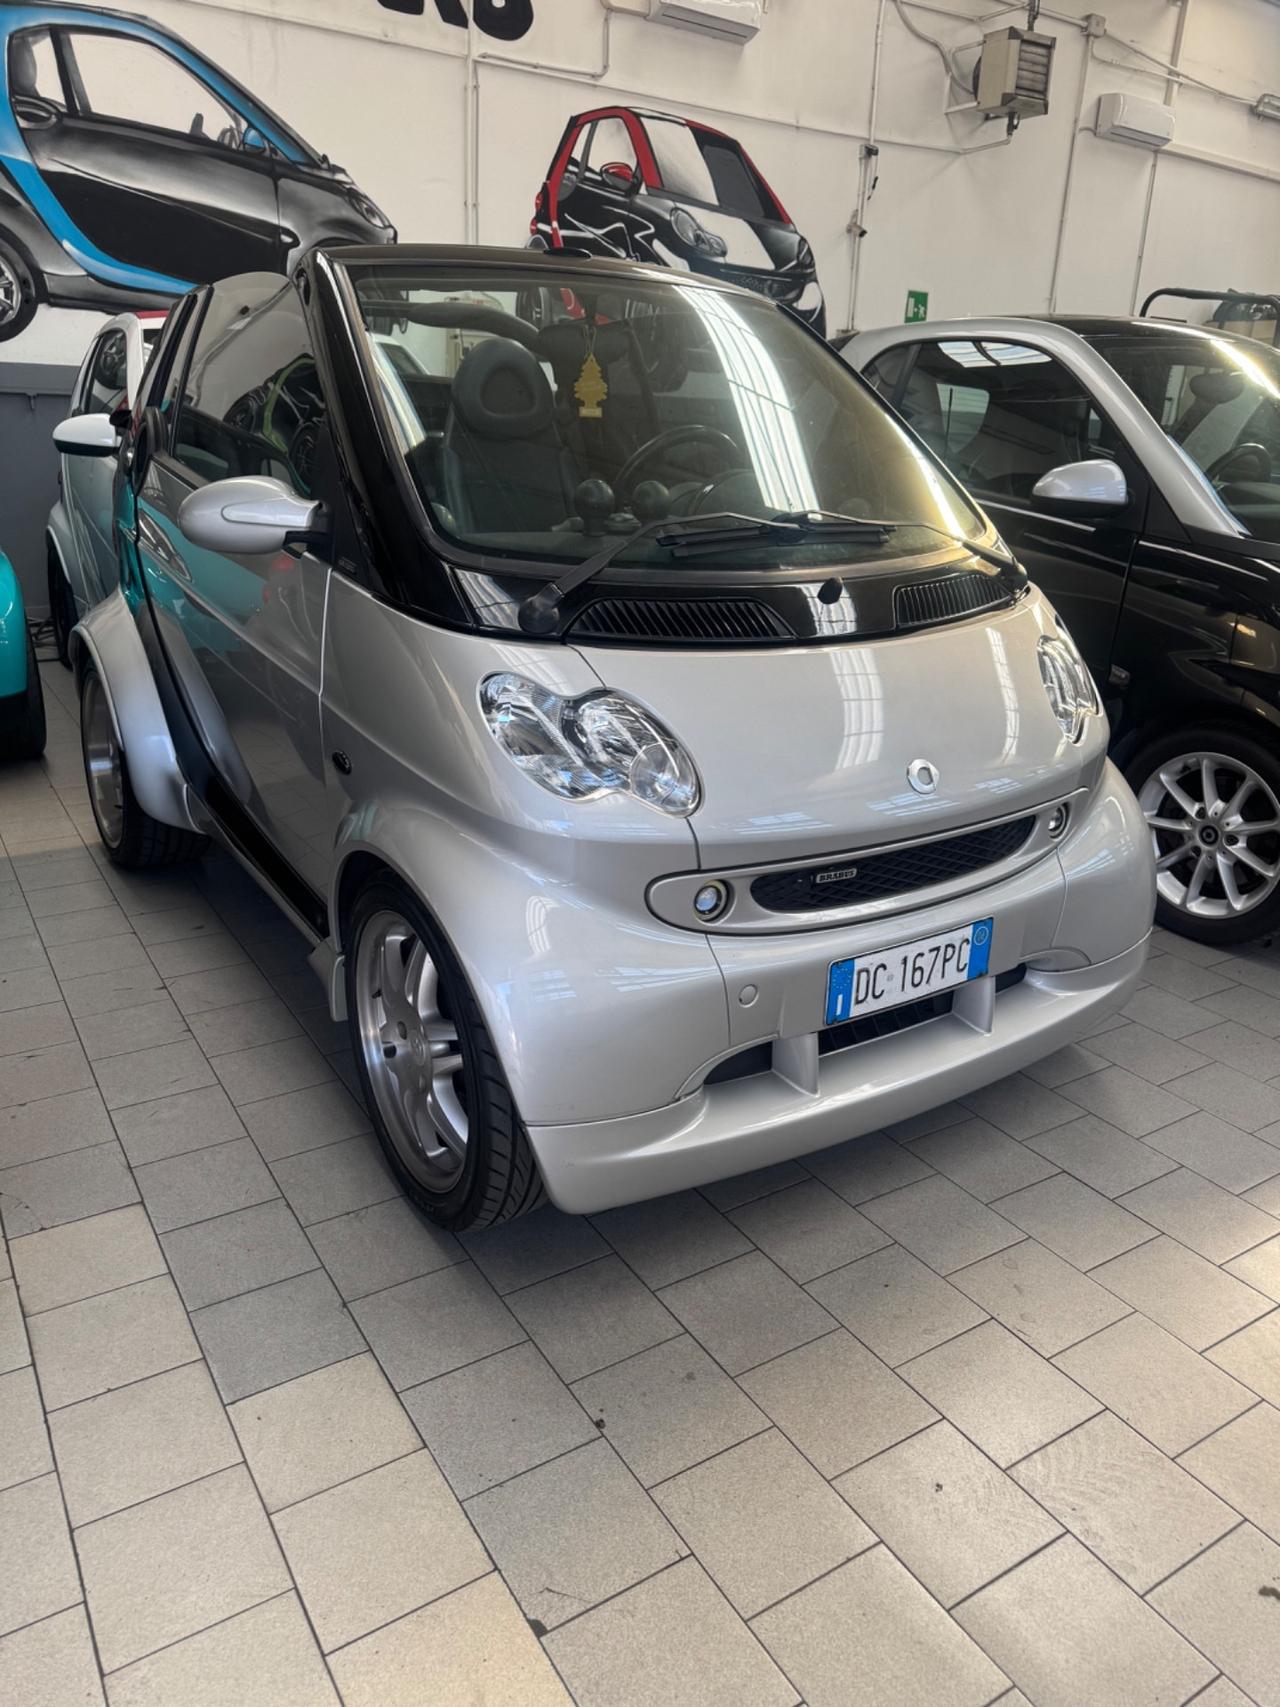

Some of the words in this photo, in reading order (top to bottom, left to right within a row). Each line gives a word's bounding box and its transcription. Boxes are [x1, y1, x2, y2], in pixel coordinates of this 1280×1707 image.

[818, 868, 856, 882] BRABUS
[855, 963, 887, 1005] DC
[901, 938, 970, 992] 167PC
